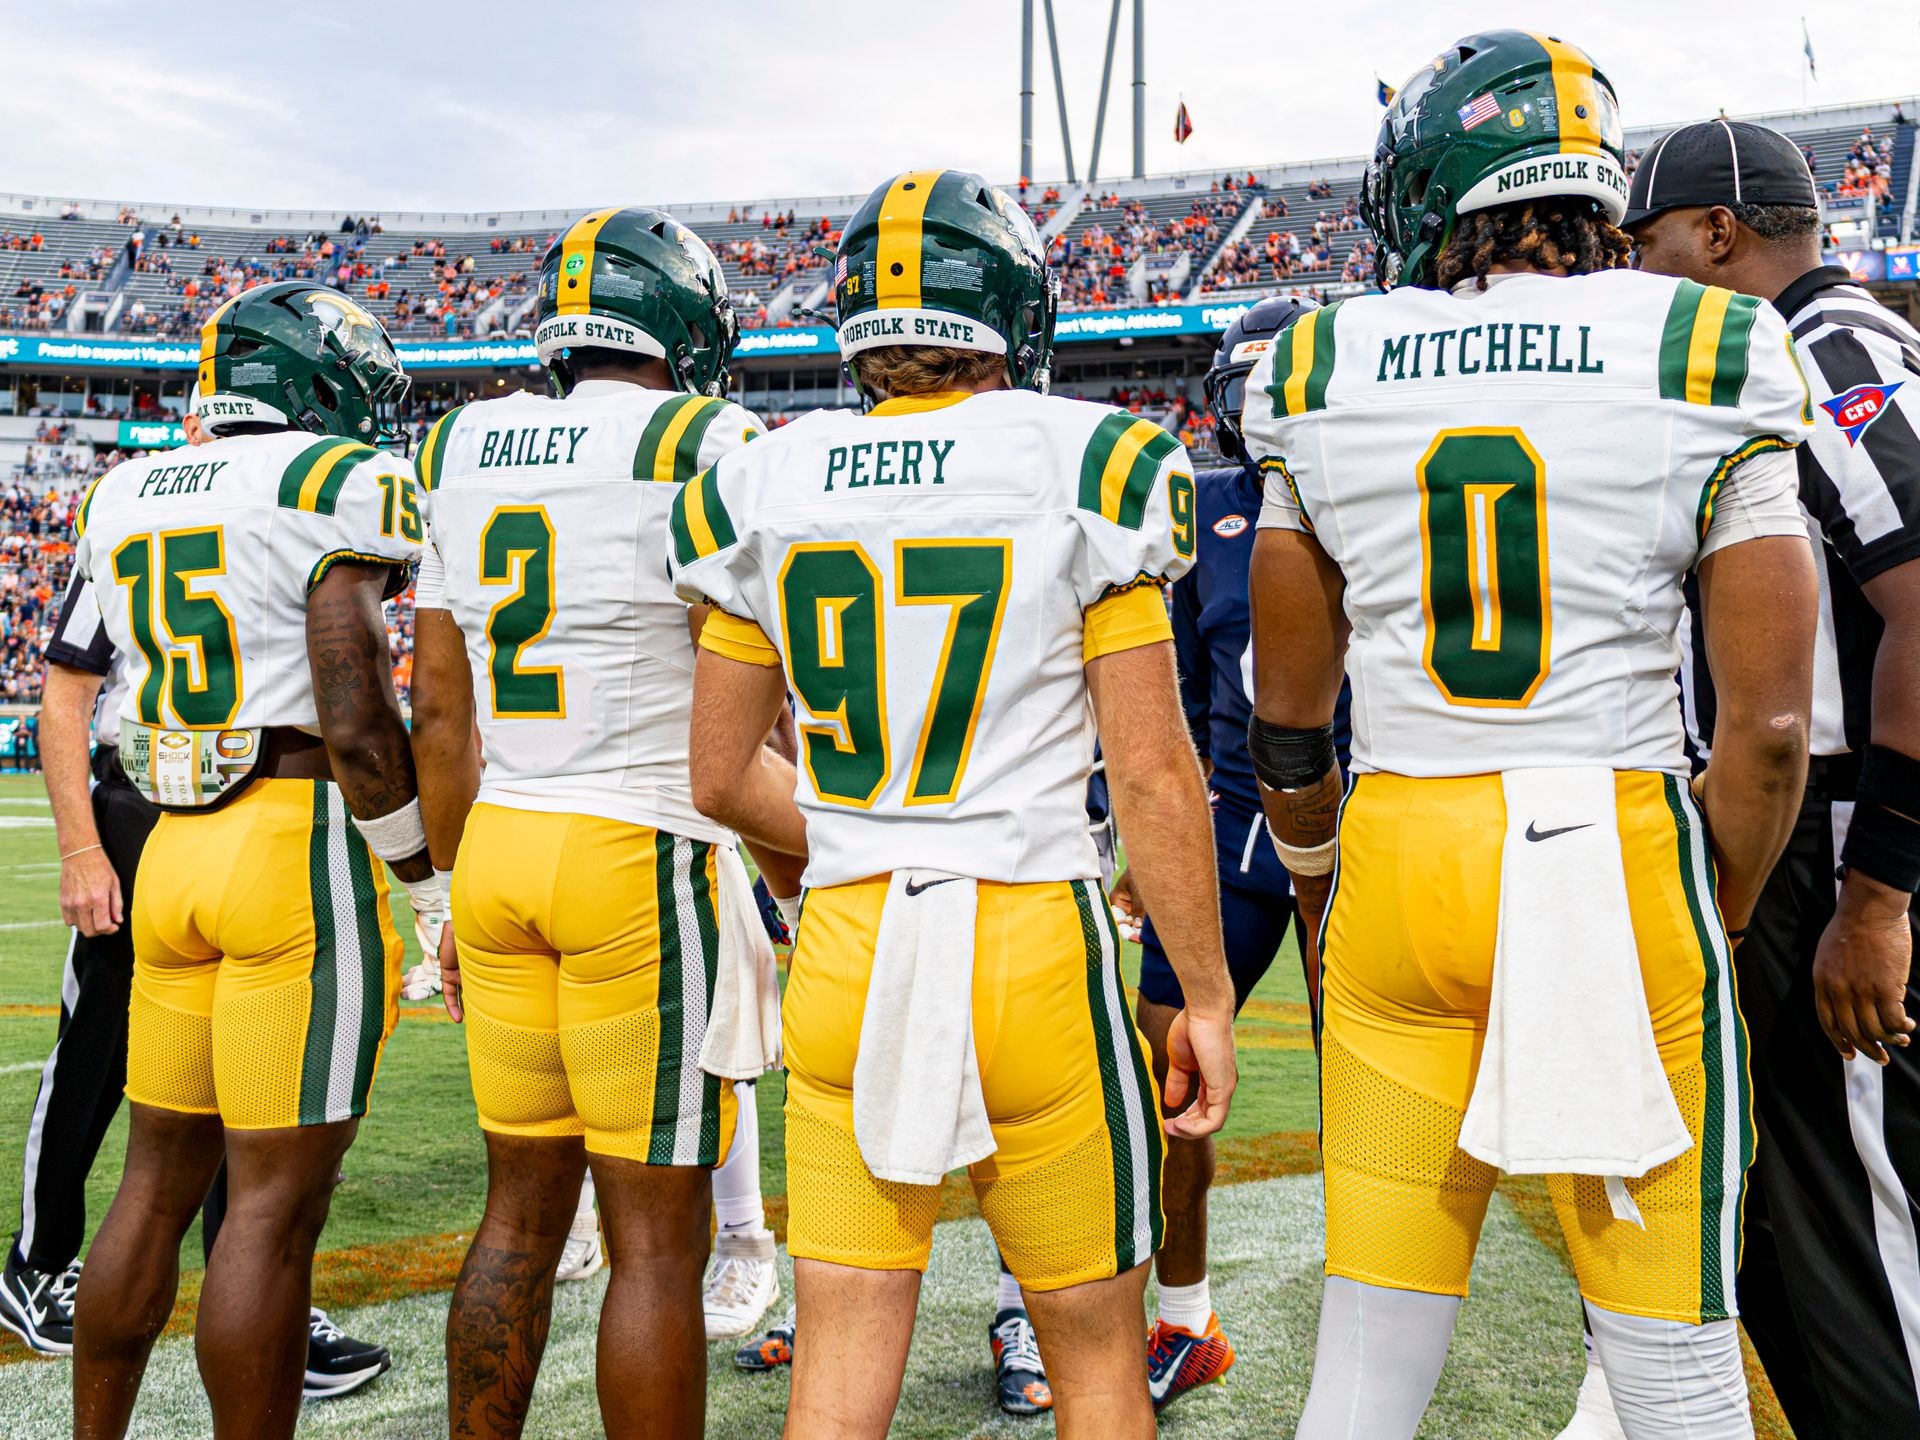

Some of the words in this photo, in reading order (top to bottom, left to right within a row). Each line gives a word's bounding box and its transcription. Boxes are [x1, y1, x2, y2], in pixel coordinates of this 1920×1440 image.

[1497, 161, 1588, 193] NORFOLK
[943, 258, 967, 266] WARNING
[846, 275, 860, 296] 97
[536, 321, 577, 345] NORFOLK
[585, 322, 635, 345] STATE
[843, 317, 905, 346] NORFOLK
[914, 318, 974, 344] STATE
[1125, 312, 1183, 331] Athletics
[38, 342, 77, 359] Proud
[77, 345, 91, 359] to
[91, 347, 141, 362] support
[1376, 322, 1604, 383] MITCHELL
[213, 402, 255, 415] STATE
[1844, 399, 1878, 421] CFO
[479, 426, 589, 468] BAILEY
[138, 461, 230, 498] PERRY
[824, 439, 956, 492] PEERY
[376, 473, 425, 545] 15
[1166, 470, 1197, 560] 9
[1218, 518, 1244, 530] ACC
[1415, 425, 1552, 710] 0
[110, 523, 244, 731] 15
[479, 503, 567, 720] 2
[776, 537, 1013, 810] 97
[158, 751, 191, 760] SHOCK
